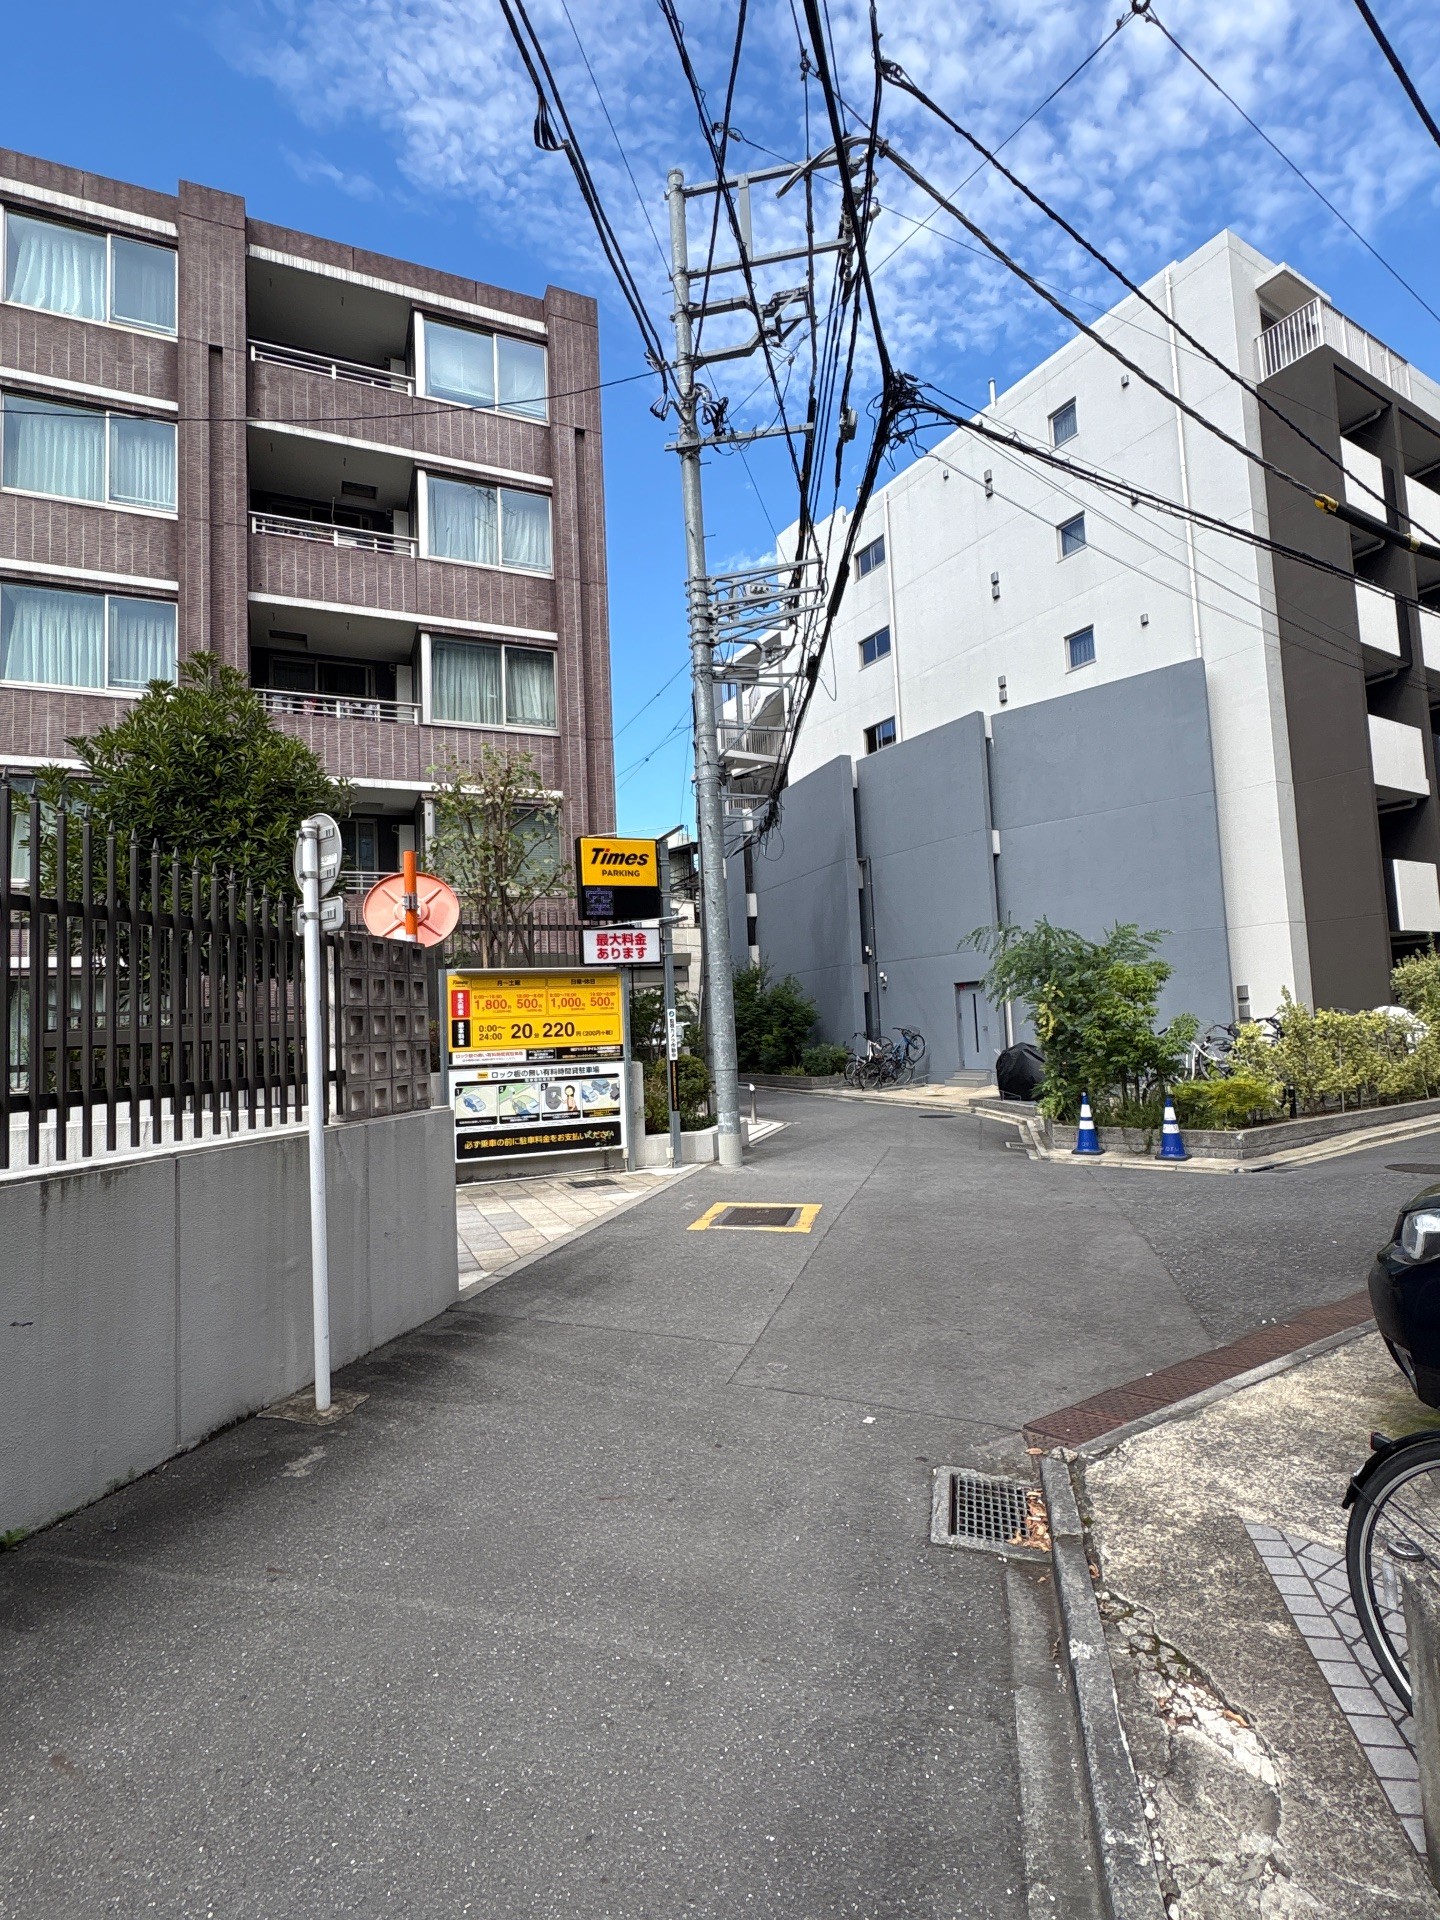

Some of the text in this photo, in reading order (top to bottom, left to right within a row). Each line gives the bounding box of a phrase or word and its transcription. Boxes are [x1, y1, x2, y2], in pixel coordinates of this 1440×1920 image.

[591, 848, 649, 866] Times
[602, 869, 640, 877] PARKING
[596, 933, 647, 946] 最大料金
[597, 947, 647, 959] あります
